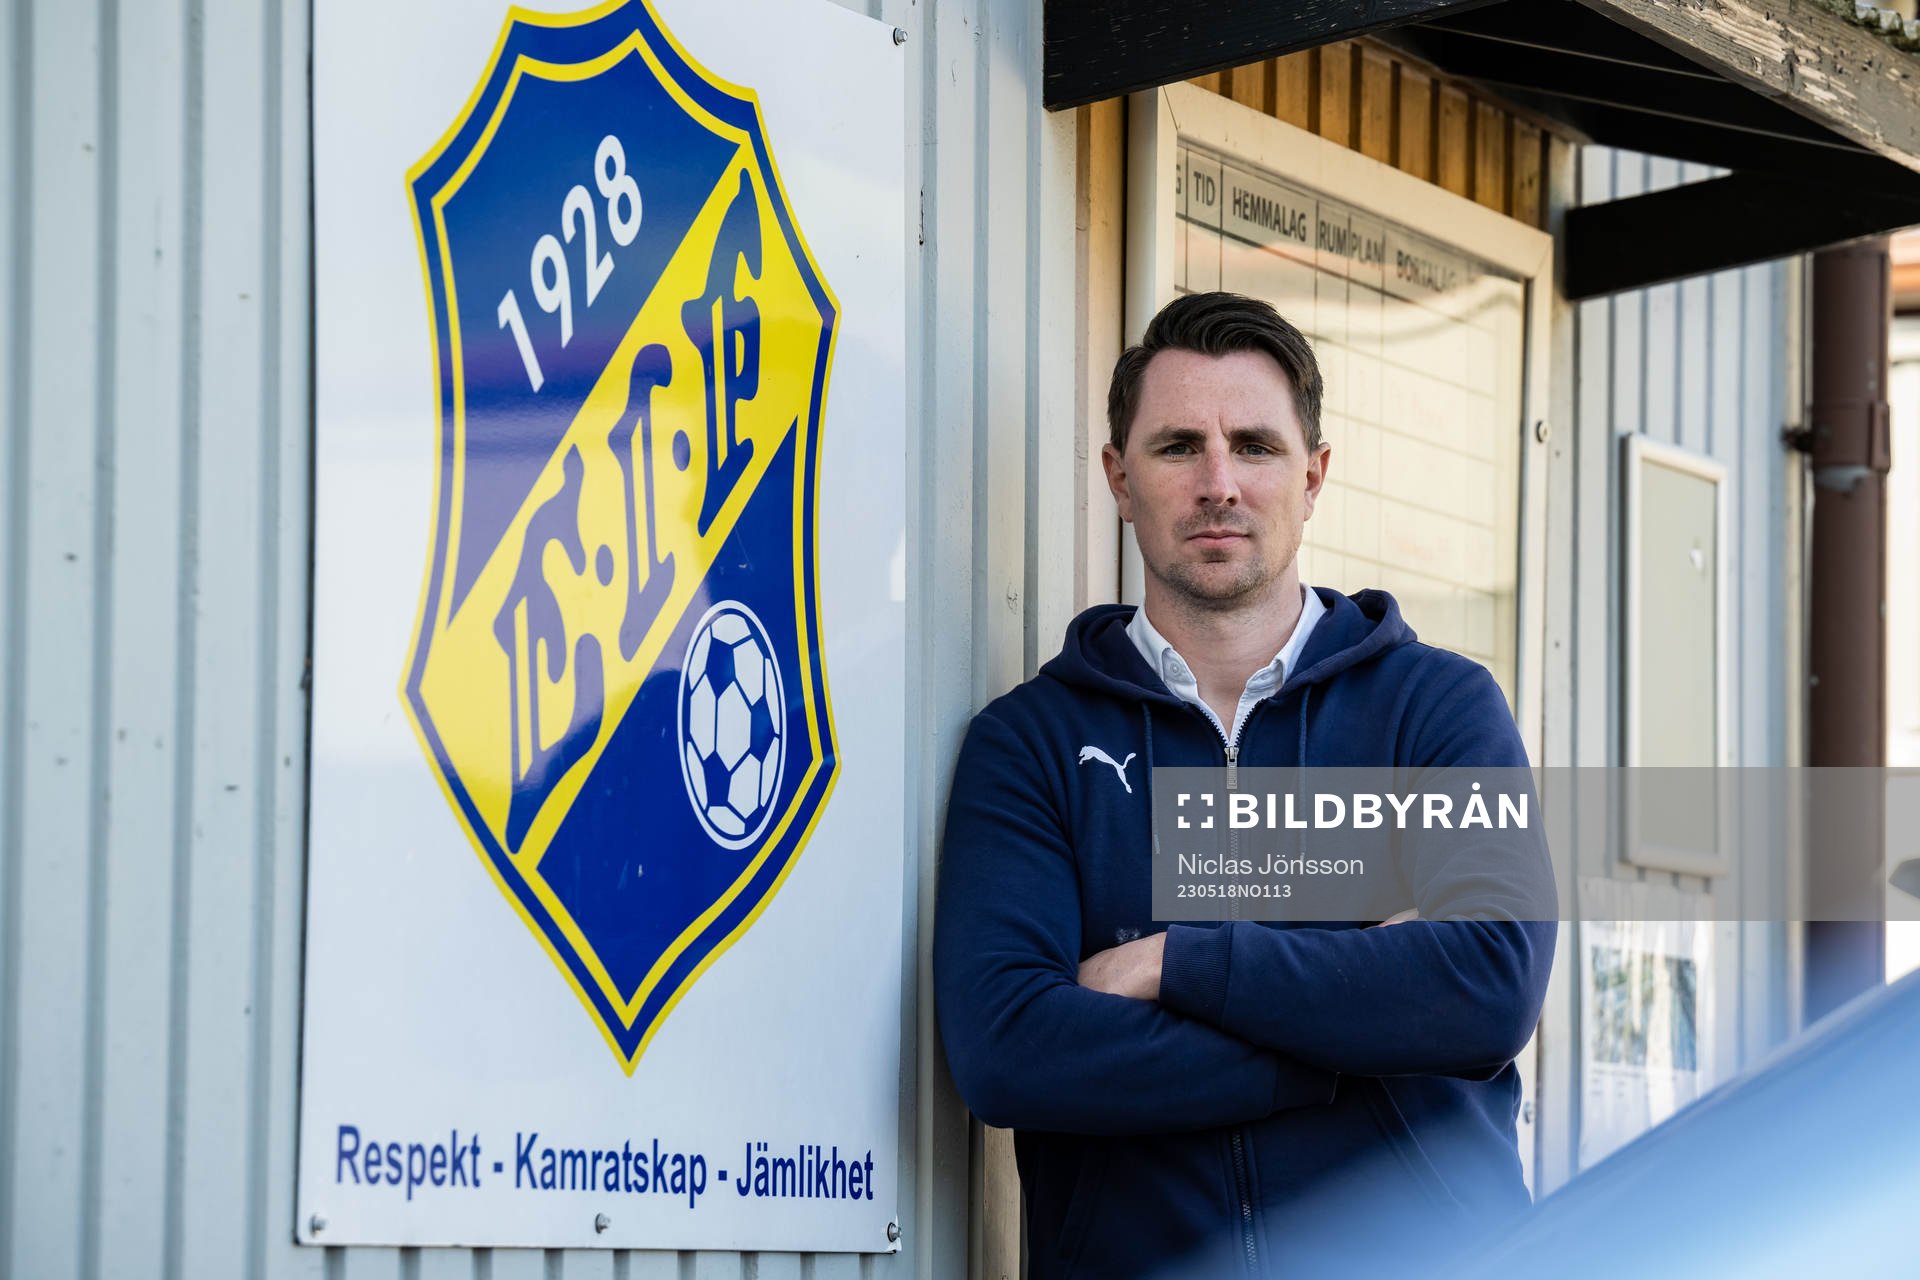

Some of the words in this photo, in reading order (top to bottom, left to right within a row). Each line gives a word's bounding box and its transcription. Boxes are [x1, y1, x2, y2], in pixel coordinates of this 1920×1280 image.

[1193, 171, 1216, 206] TID
[1232, 186, 1307, 242] HEMMALAG
[1319, 220, 1347, 255] RUM
[497, 134, 643, 393] 1928
[1351, 231, 1382, 270] PLAN
[337, 1125, 481, 1201] Respekt
[515, 1132, 706, 1209] Kamratskap
[736, 1142, 874, 1201] Jämlikhet
